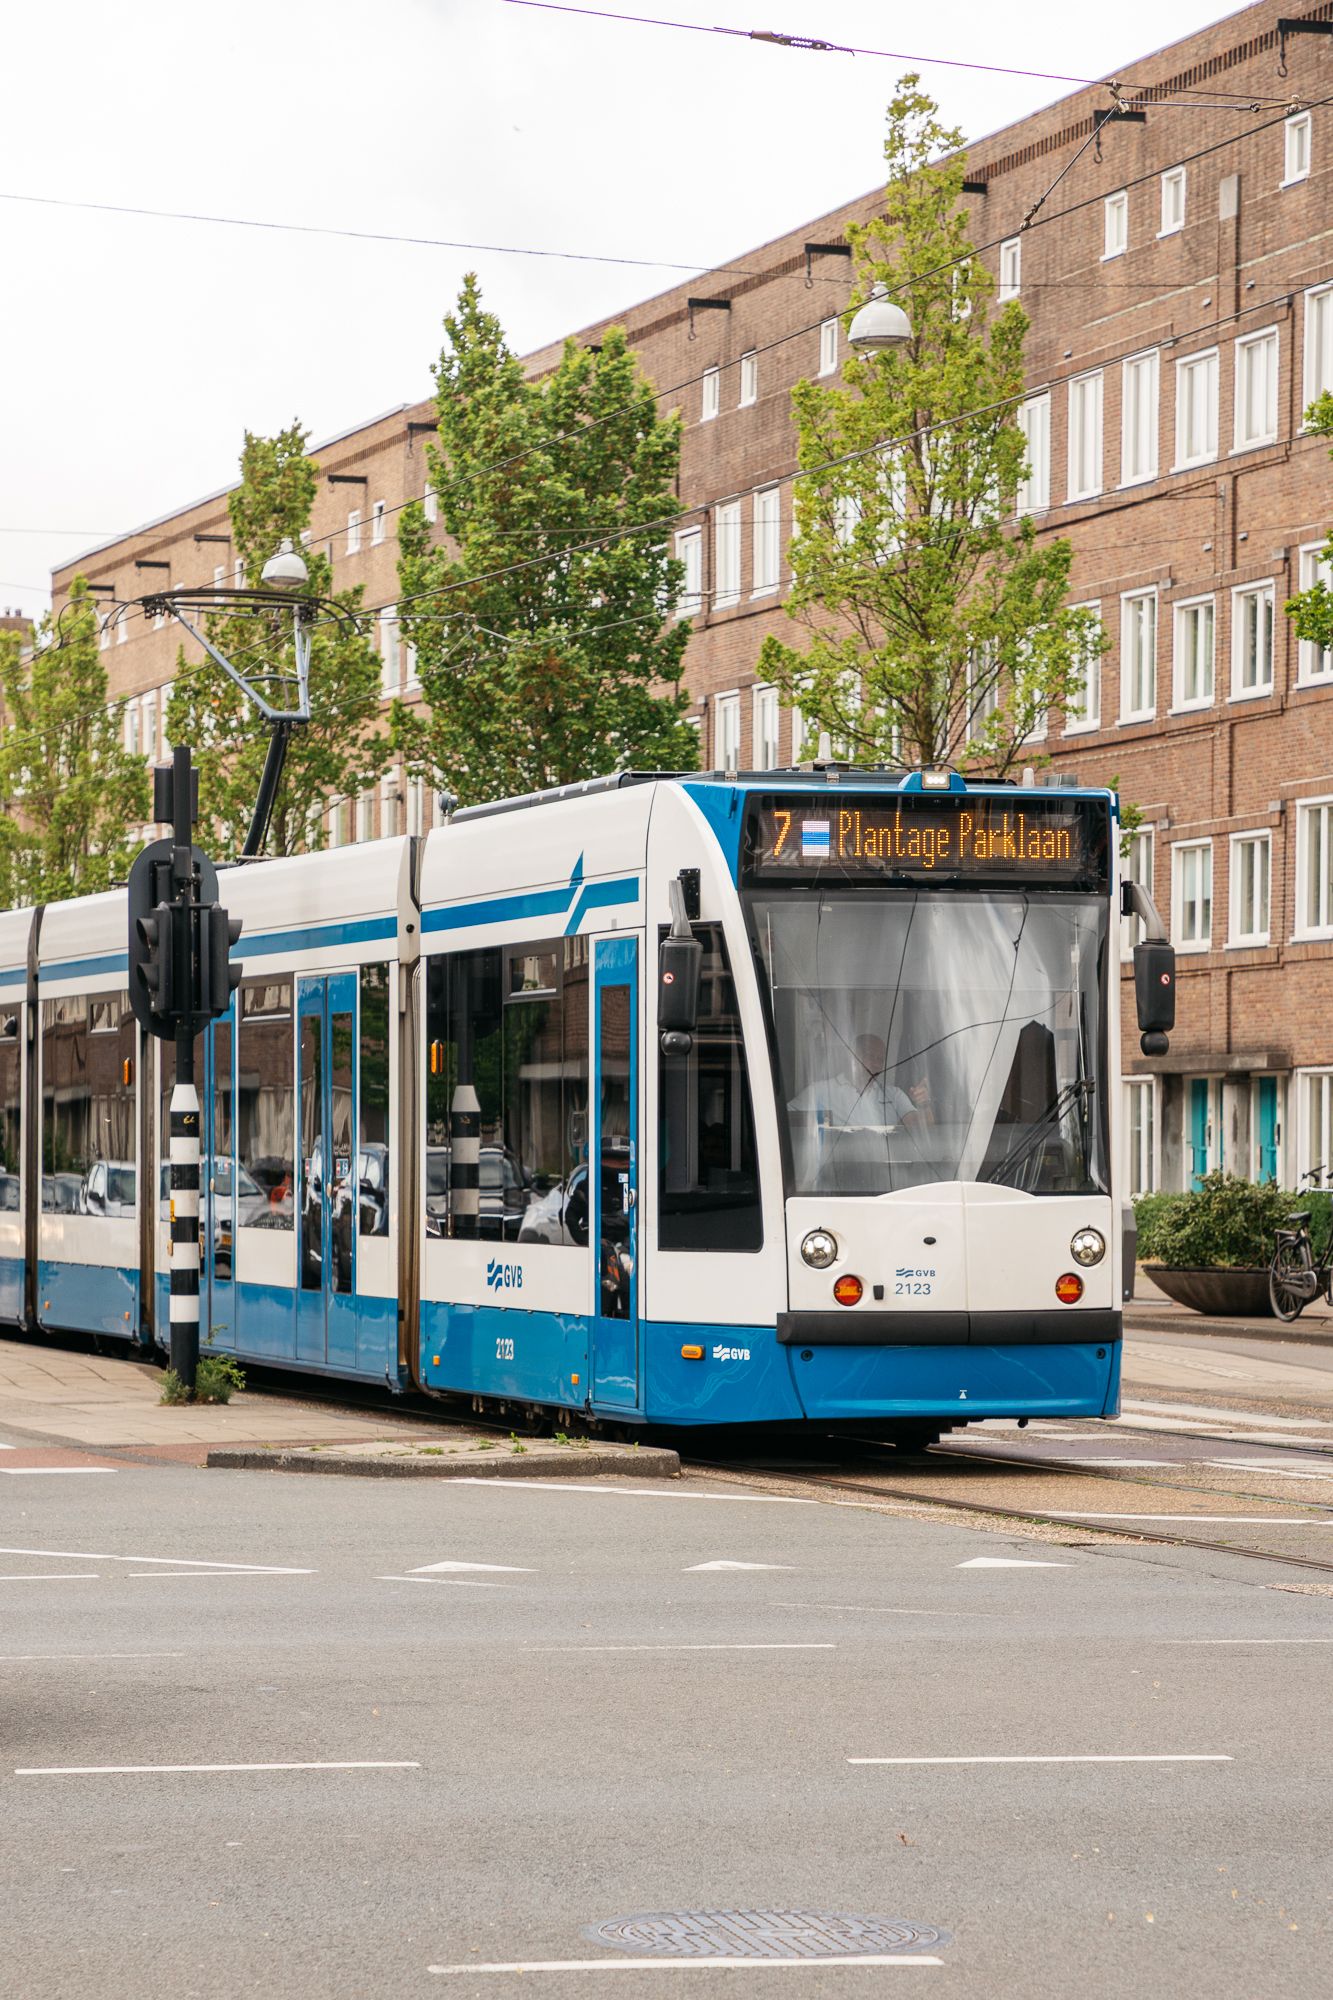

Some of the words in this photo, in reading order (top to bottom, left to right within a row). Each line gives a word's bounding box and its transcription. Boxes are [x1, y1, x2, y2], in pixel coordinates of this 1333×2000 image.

[773, 811, 791, 856] 7
[839, 810, 949, 868] Plantage
[960, 812, 1070, 859] Parklaan
[504, 1264, 523, 1288] GVB
[915, 1269, 936, 1277] GVB
[895, 1282, 932, 1295] 2123
[496, 1337, 514, 1360] 2123
[731, 1347, 751, 1361] GVB
